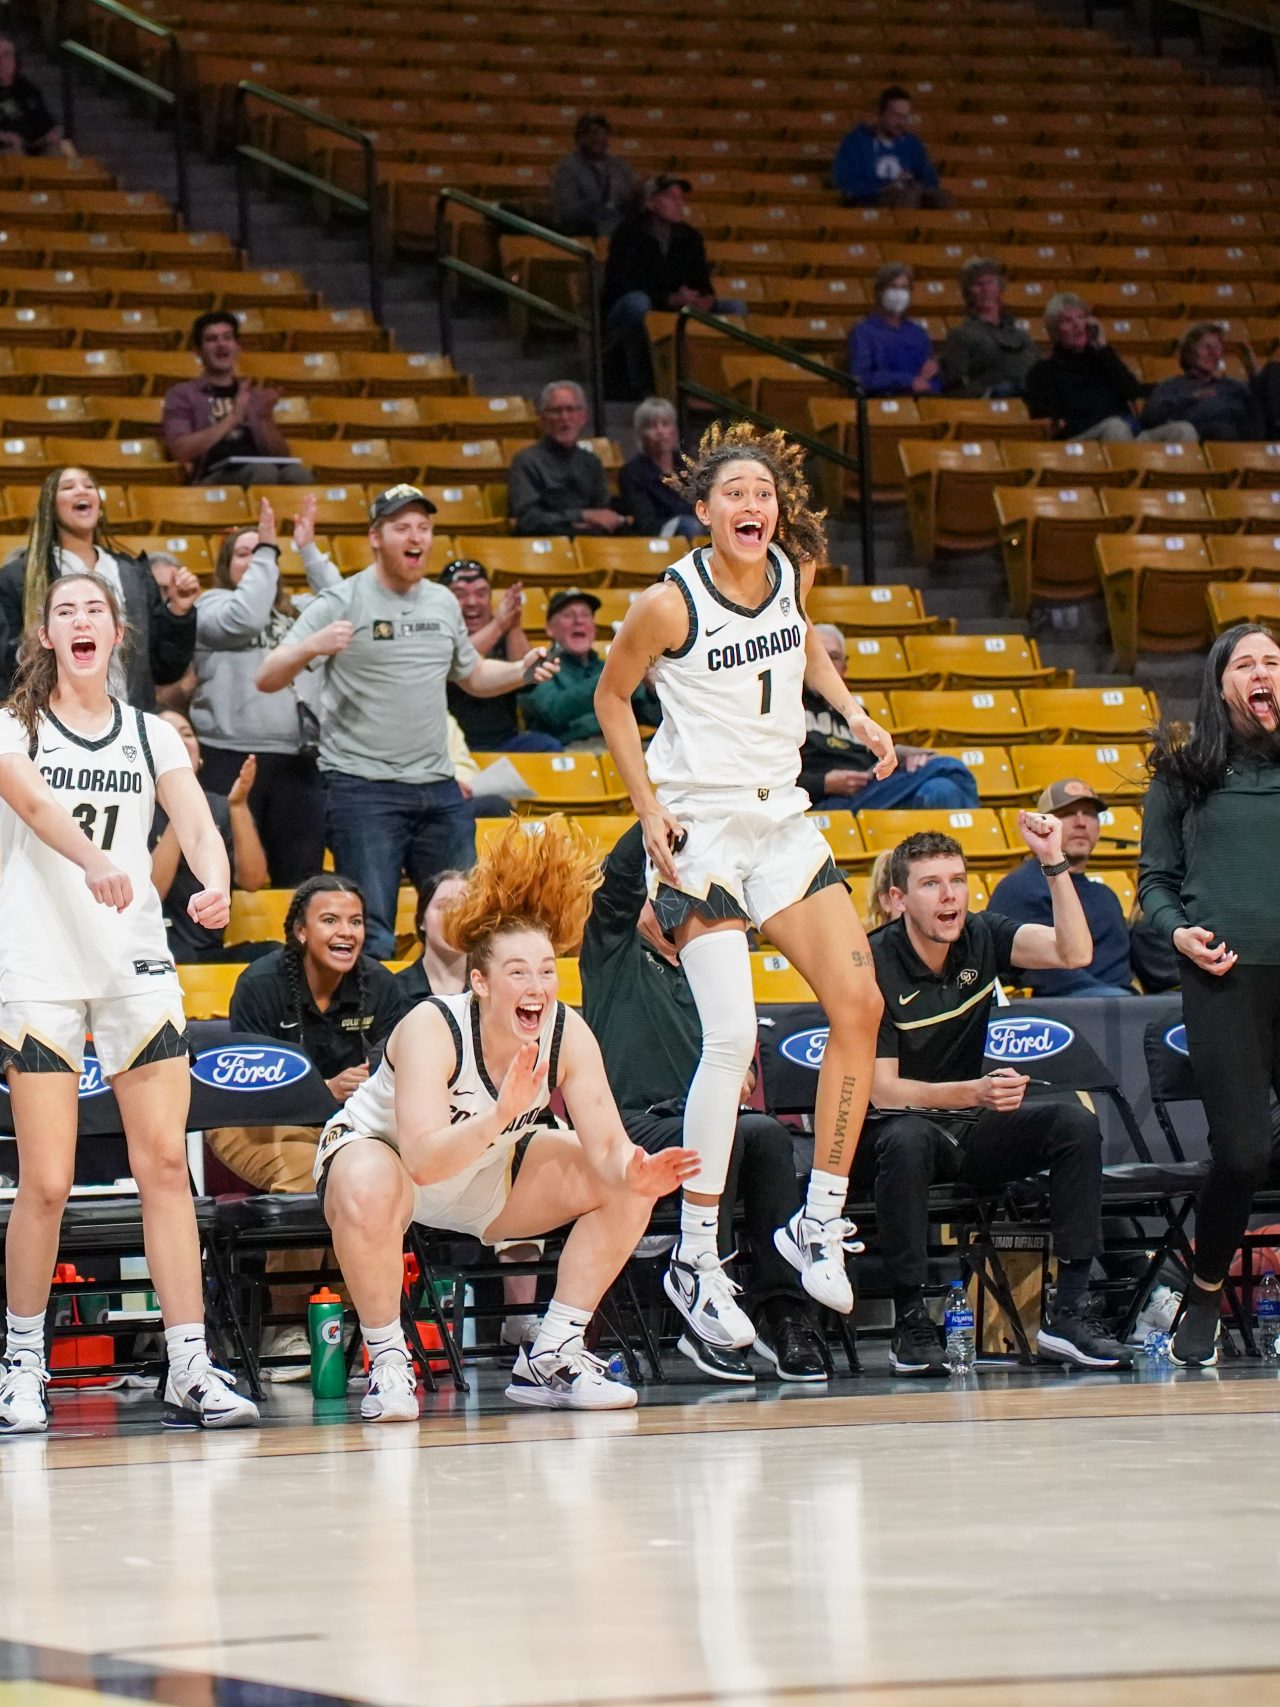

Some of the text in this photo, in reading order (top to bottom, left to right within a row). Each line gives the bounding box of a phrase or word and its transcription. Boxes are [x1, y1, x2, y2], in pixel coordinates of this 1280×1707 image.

[707, 624, 801, 672] COLORADO
[757, 668, 772, 716] 1
[71, 802, 120, 851] 31
[989, 1023, 1053, 1056] Ford
[212, 1052, 287, 1084] Ford
